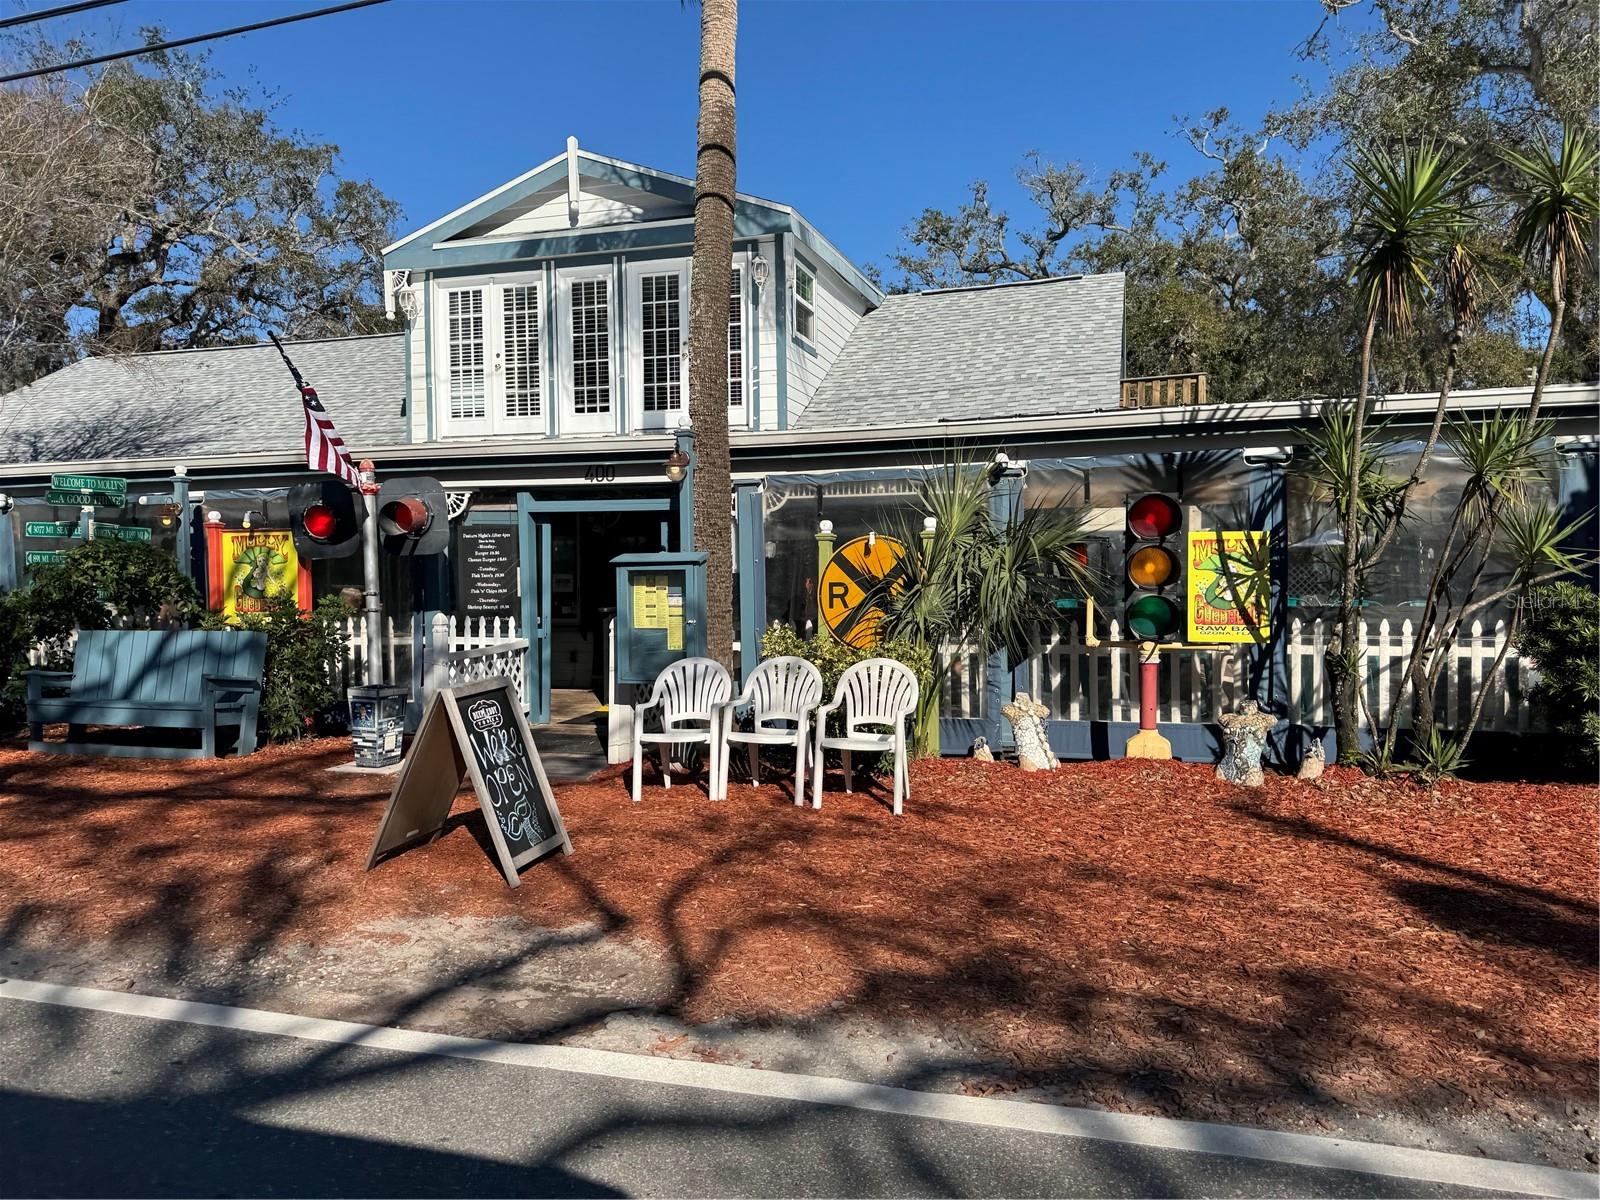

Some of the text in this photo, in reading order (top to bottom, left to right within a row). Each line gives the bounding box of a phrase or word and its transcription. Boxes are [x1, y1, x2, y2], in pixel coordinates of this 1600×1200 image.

[53, 475, 86, 489] WELCOME
[87, 479, 97, 489] TO
[584, 465, 616, 482] 400
[67, 494, 91, 504] GOOD
[231, 534, 289, 560] MOLLY
[828, 581, 850, 609] R
[485, 755, 535, 808] OPEN
